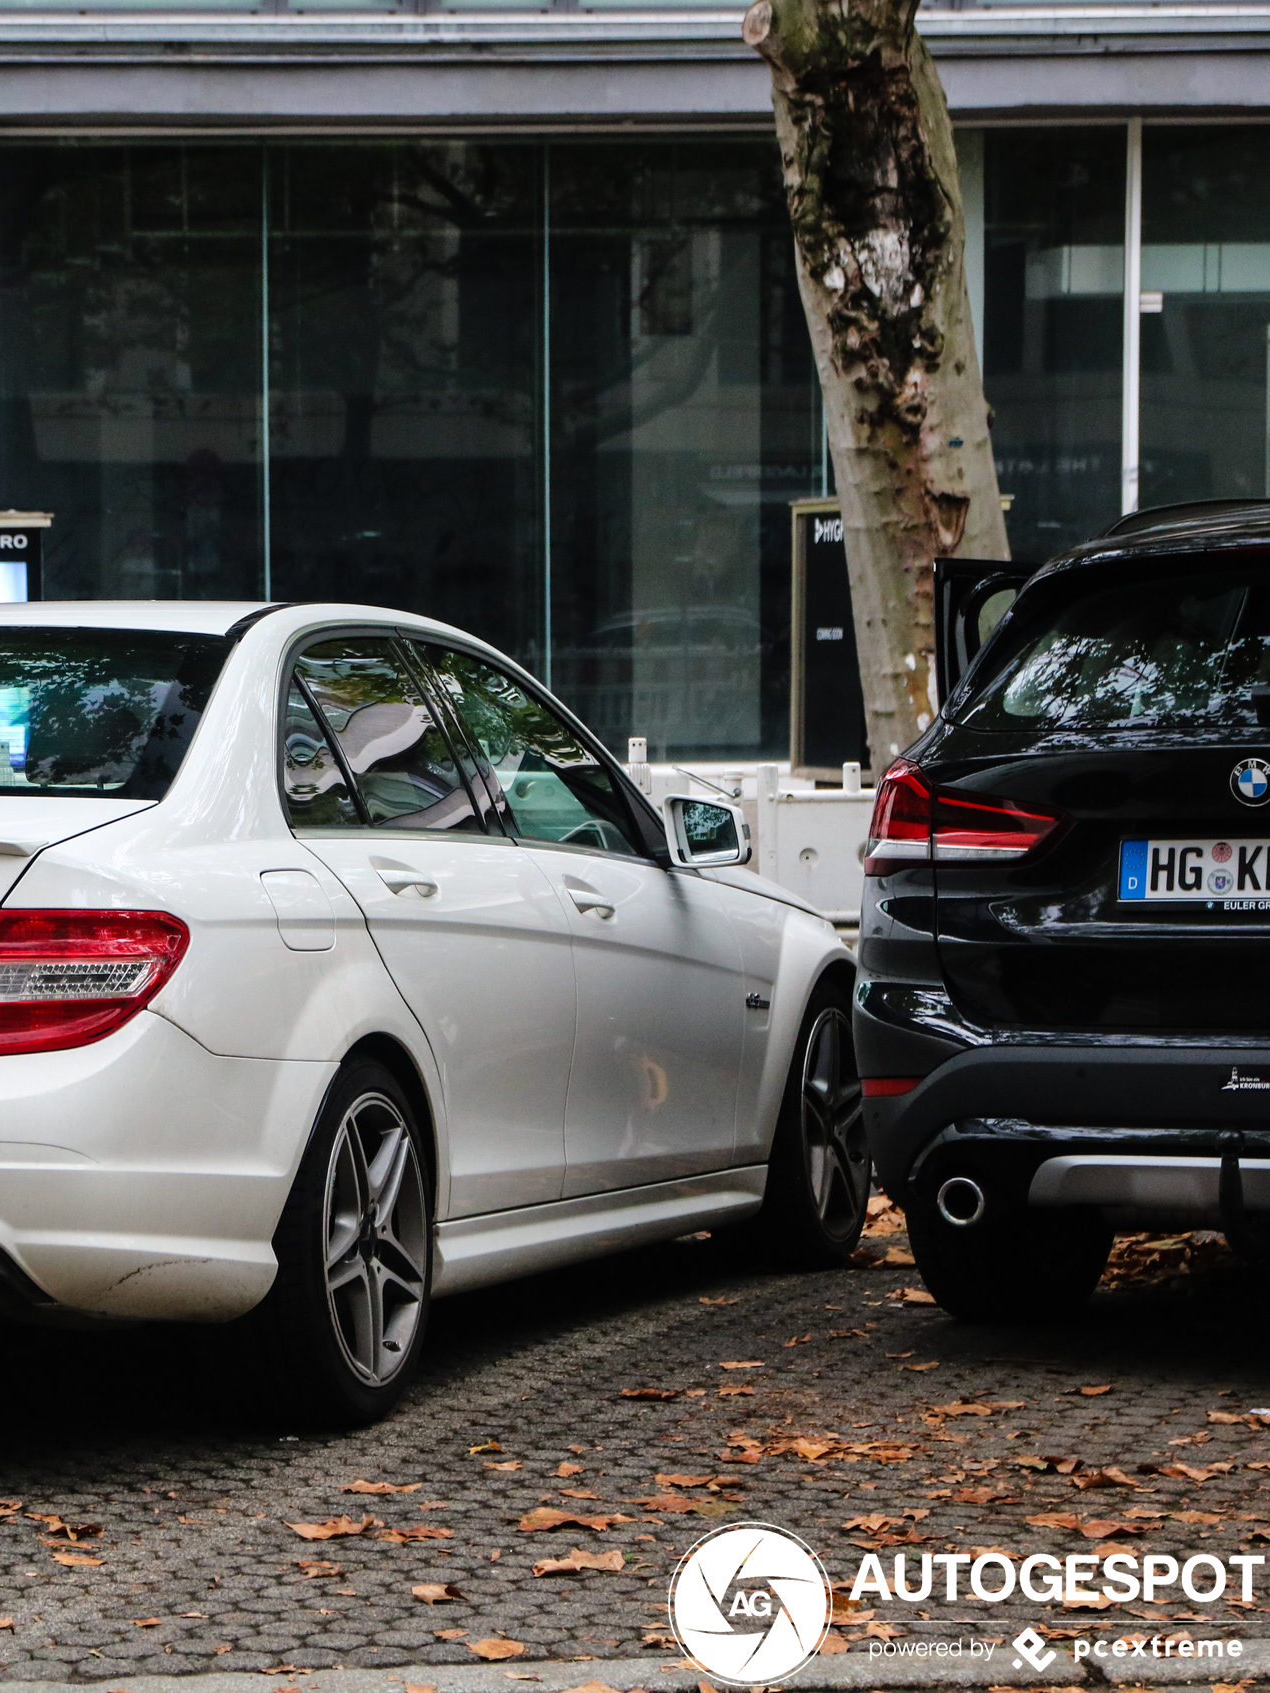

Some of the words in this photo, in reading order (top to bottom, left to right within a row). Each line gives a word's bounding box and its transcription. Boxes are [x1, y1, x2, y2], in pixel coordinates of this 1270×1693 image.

[1150, 847, 1204, 892] HG
[1237, 846, 1270, 891] K
[1128, 877, 1138, 890] D
[1223, 901, 1256, 910] EULER
